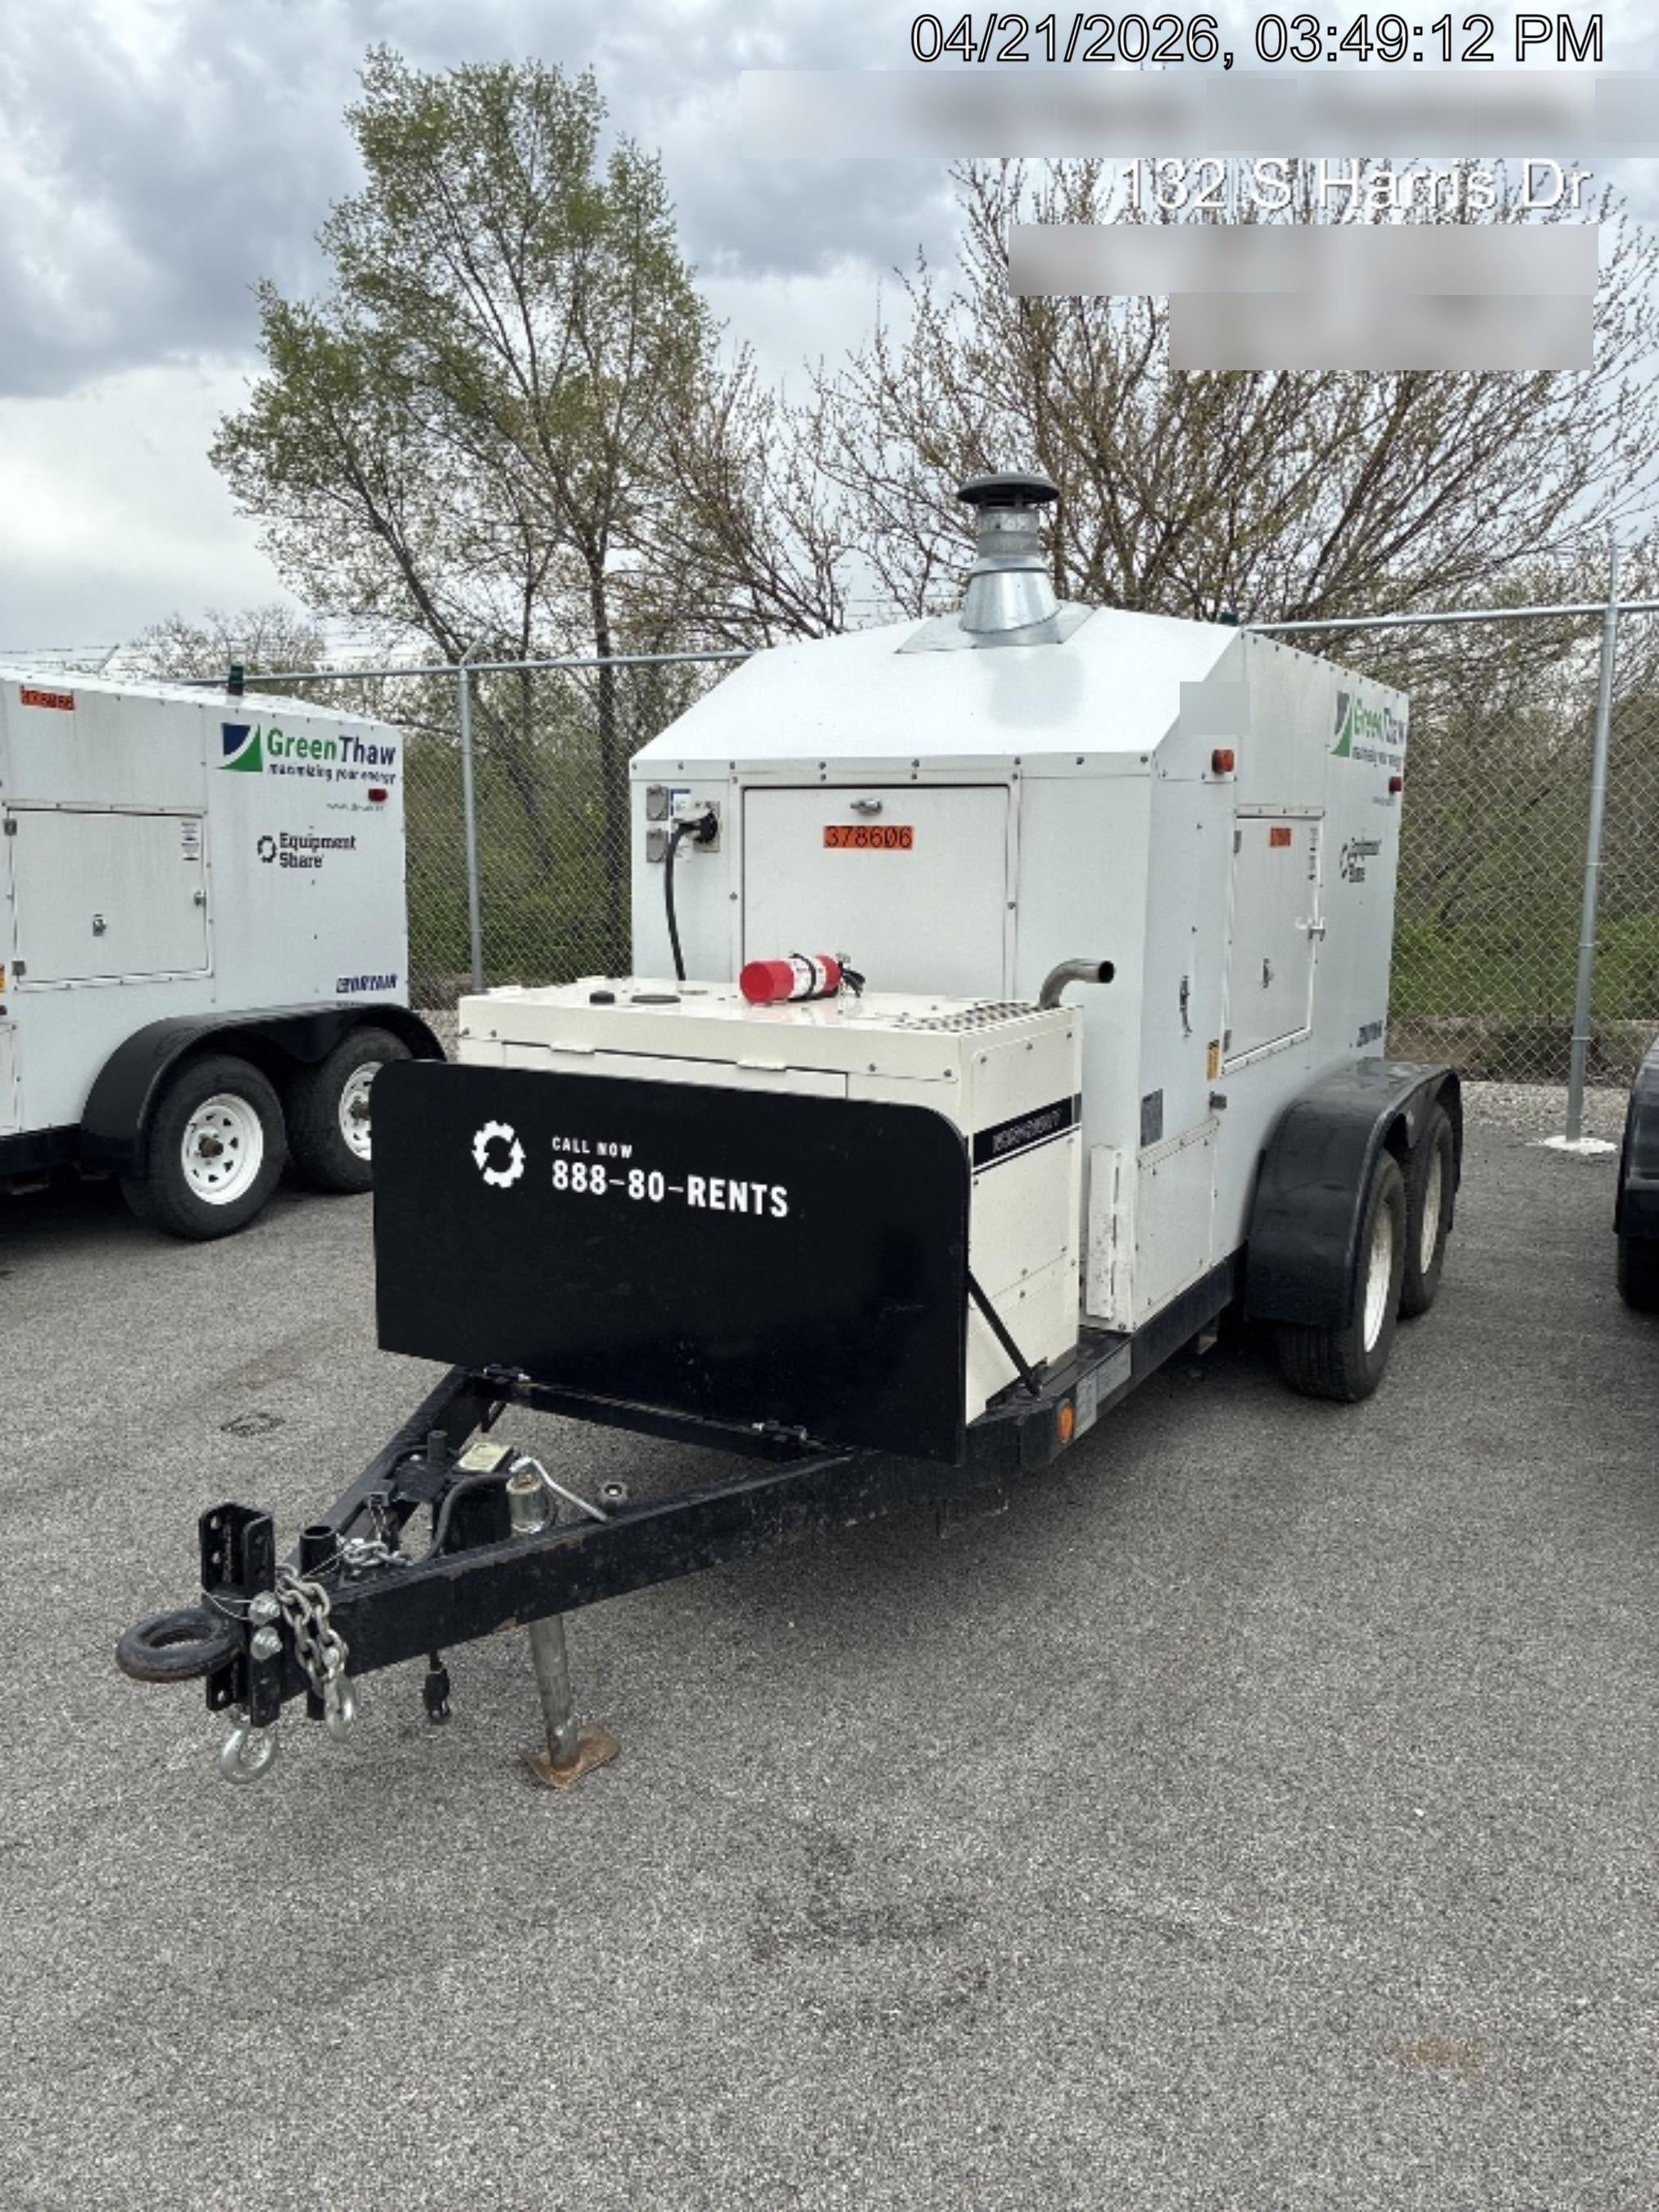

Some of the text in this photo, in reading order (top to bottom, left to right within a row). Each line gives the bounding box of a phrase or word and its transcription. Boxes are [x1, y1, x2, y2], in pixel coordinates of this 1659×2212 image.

[267, 728, 396, 765] GreenThaw
[279, 832, 356, 852] Equipment
[825, 826, 912, 848] 378606
[279, 852, 322, 868] Share
[552, 1135, 633, 1159] CALL NOW
[552, 1159, 788, 1217] 888-80-RENTS
